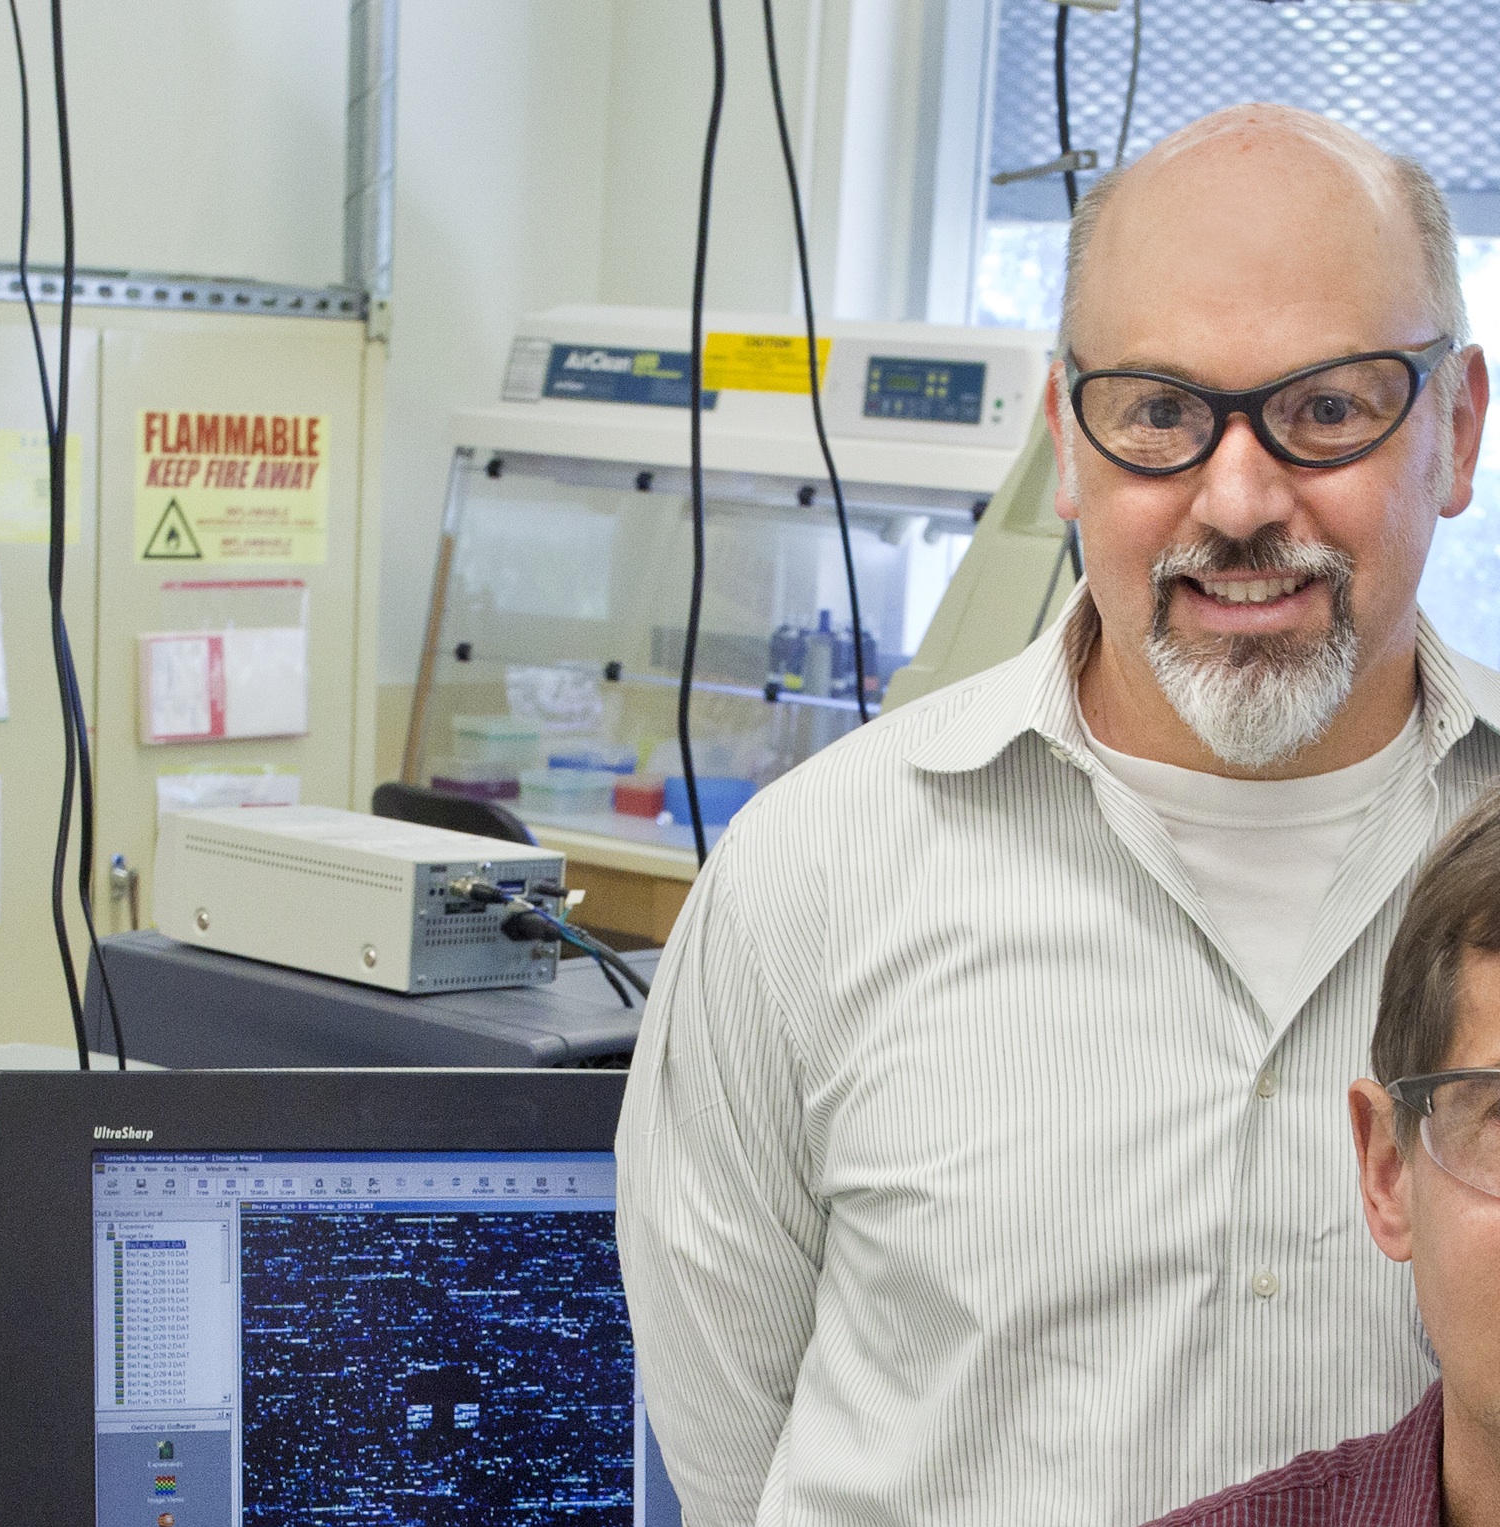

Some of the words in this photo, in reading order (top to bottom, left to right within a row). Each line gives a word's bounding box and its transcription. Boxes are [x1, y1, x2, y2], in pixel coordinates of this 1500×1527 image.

[145, 412, 320, 457] FLAMMABLE
[146, 459, 200, 488] KEEP
[204, 460, 250, 489] FIRE
[253, 461, 319, 490] AWAY
[94, 1126, 154, 1141] UltraSharp
